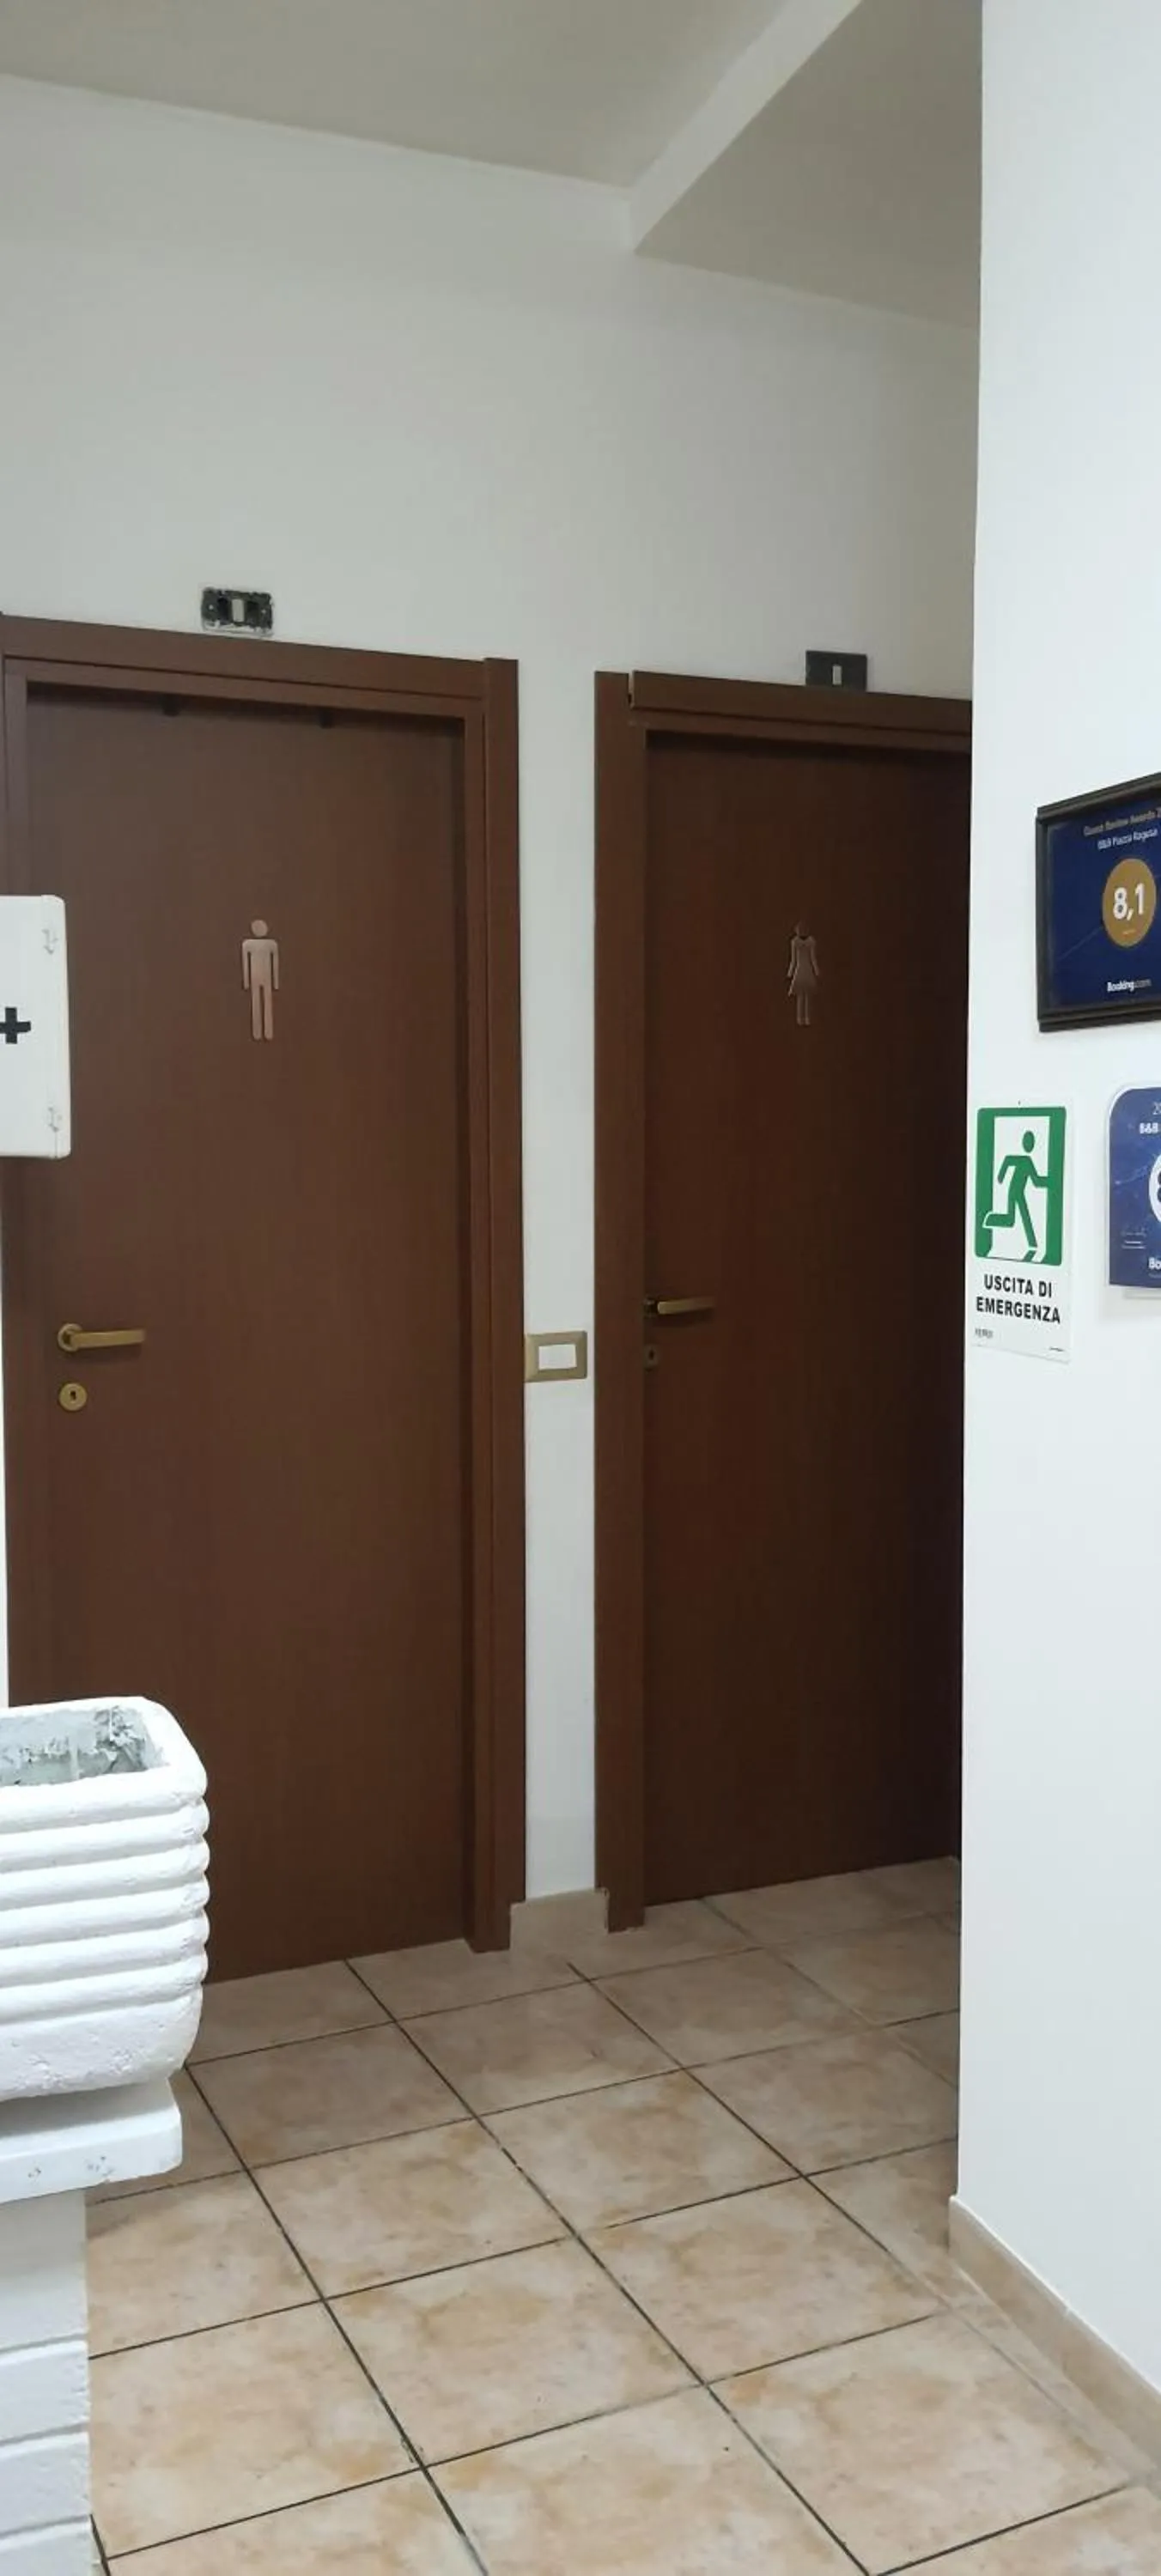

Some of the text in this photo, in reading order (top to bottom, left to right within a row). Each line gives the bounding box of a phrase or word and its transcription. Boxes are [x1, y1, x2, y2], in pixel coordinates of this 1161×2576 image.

[1113, 883, 1145, 921] 8,1
[1107, 978, 1152, 993] Booking.com
[983, 1273, 1052, 1298] USCITA DI
[976, 1296, 1061, 1325] EMERGENZA
